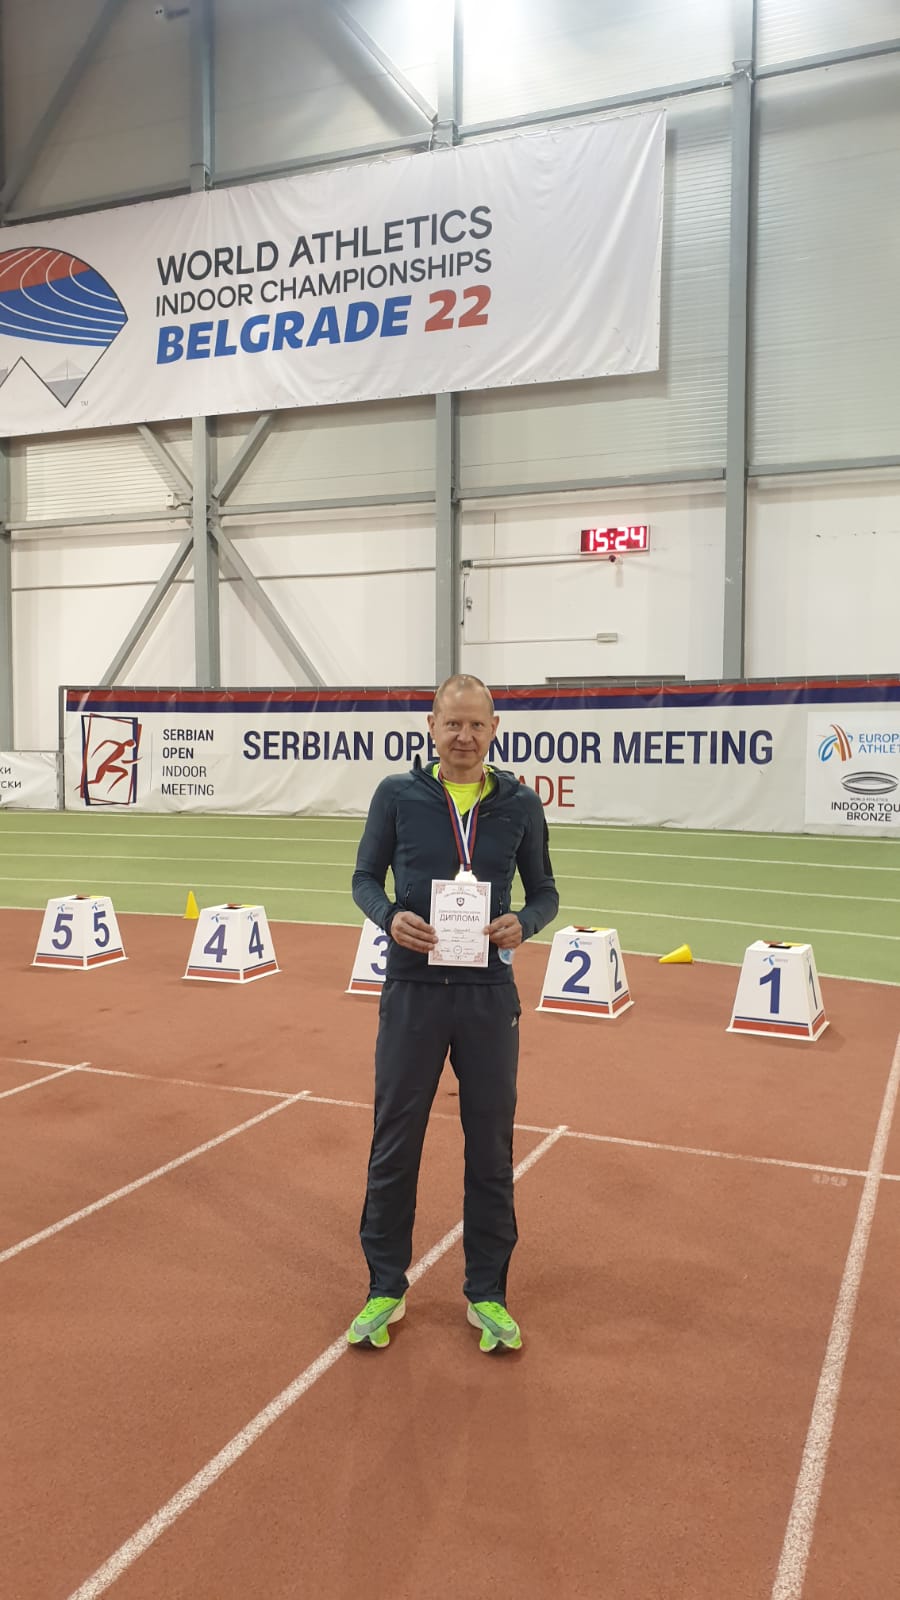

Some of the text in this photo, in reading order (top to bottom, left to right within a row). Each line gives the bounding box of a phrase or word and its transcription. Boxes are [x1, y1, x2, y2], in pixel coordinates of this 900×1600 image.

[156, 205, 493, 286] WORLD ATHLETICS
[156, 248, 492, 318] INDOOR CHAMPIONSHIPS
[156, 284, 492, 365] BELGRADE 22
[589, 526, 645, 552] 15:24
[162, 747, 194, 759] OPEN
[163, 728, 214, 741] SERBIAN
[243, 730, 773, 765] SERBIAN OPE NDOOR MEETING
[161, 783, 214, 796] MEETING
[162, 765, 207, 777] INDOOR
[831, 801, 875, 812] INDOOR
[846, 811, 892, 822] BRONZE
[52, 913, 74, 950] 5
[94, 910, 110, 948] 5
[440, 914, 480, 922] ДИПЛОМА
[203, 924, 228, 963] 4
[248, 920, 265, 960] 4
[371, 935, 390, 976] 3
[562, 949, 591, 995] 2
[610, 948, 623, 993] 2
[759, 967, 781, 1014] 1
